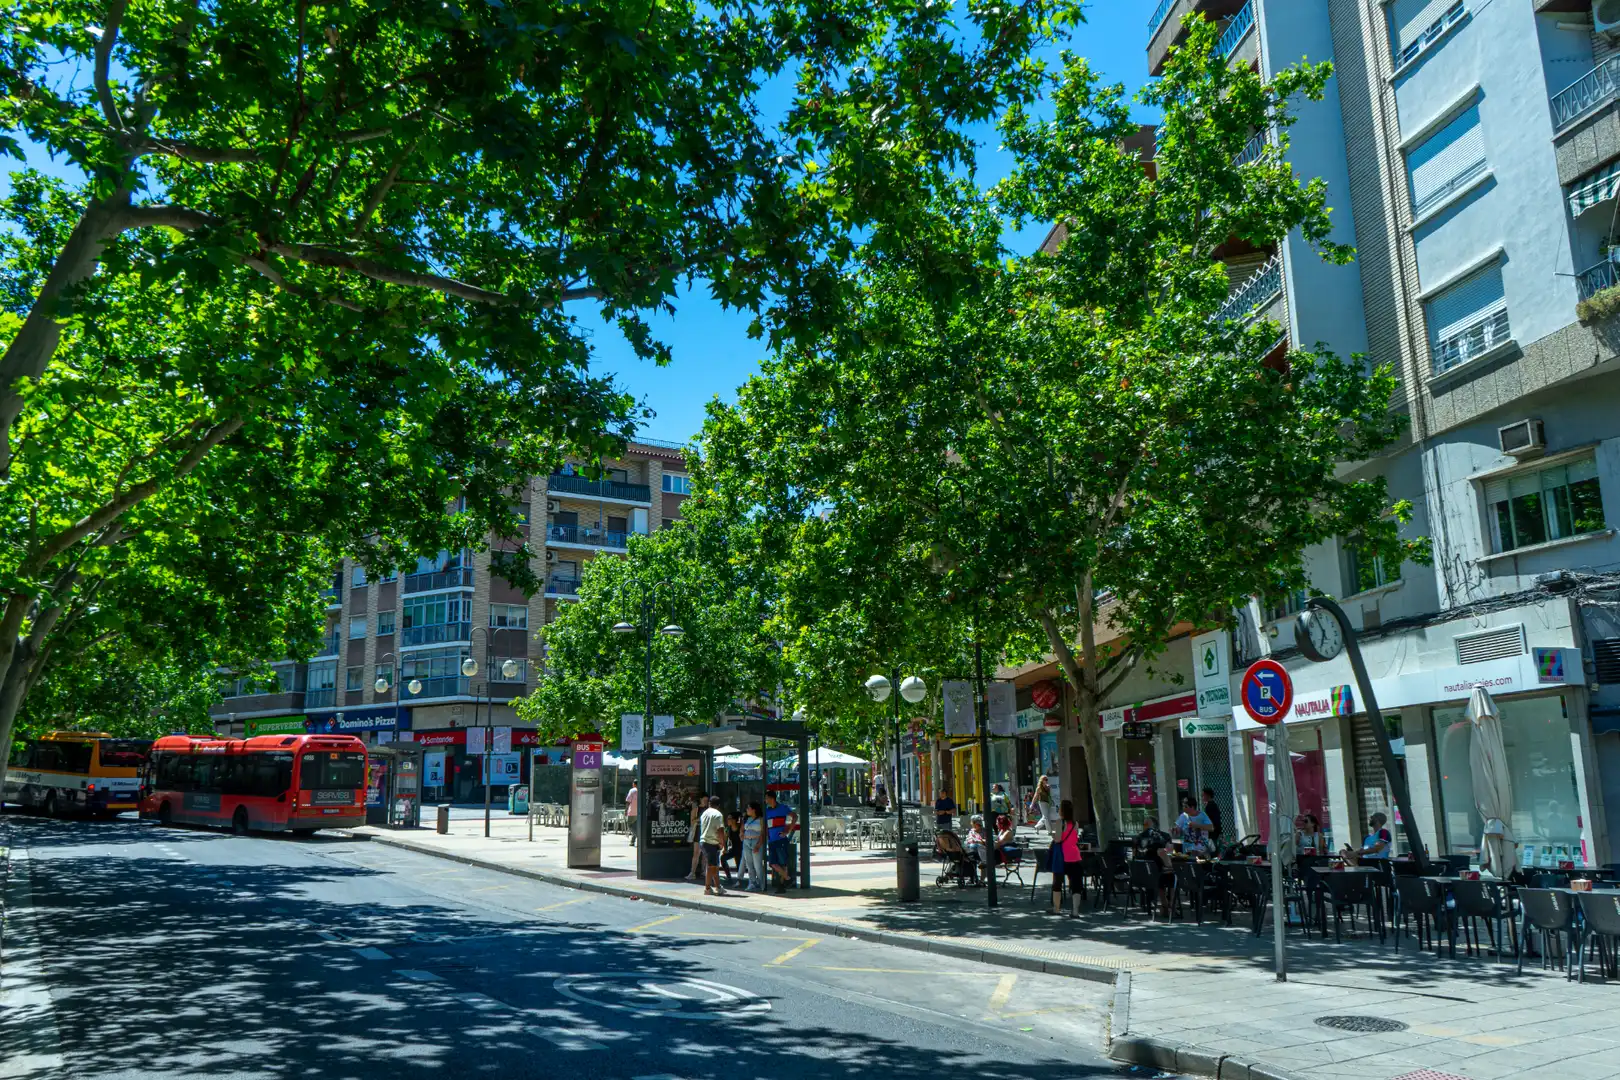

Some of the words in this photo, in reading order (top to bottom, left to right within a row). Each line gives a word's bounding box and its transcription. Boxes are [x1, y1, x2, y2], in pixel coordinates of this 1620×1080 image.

[1262, 687, 1269, 698] P
[1259, 706, 1274, 714] BUS
[1294, 699, 1331, 717] NAUTALIA
[258, 720, 303, 733] SUPERVERDE
[339, 717, 374, 729] Domino's
[375, 716, 396, 726] Pizza
[1197, 723, 1226, 732] TECNOCASA
[426, 736, 455, 744] Santander
[582, 754, 595, 766] C4
[651, 820, 660, 828] EL
[660, 820, 685, 828] SABOR
[651, 827, 661, 835] DE
[663, 825, 690, 835] ARAGÓ
